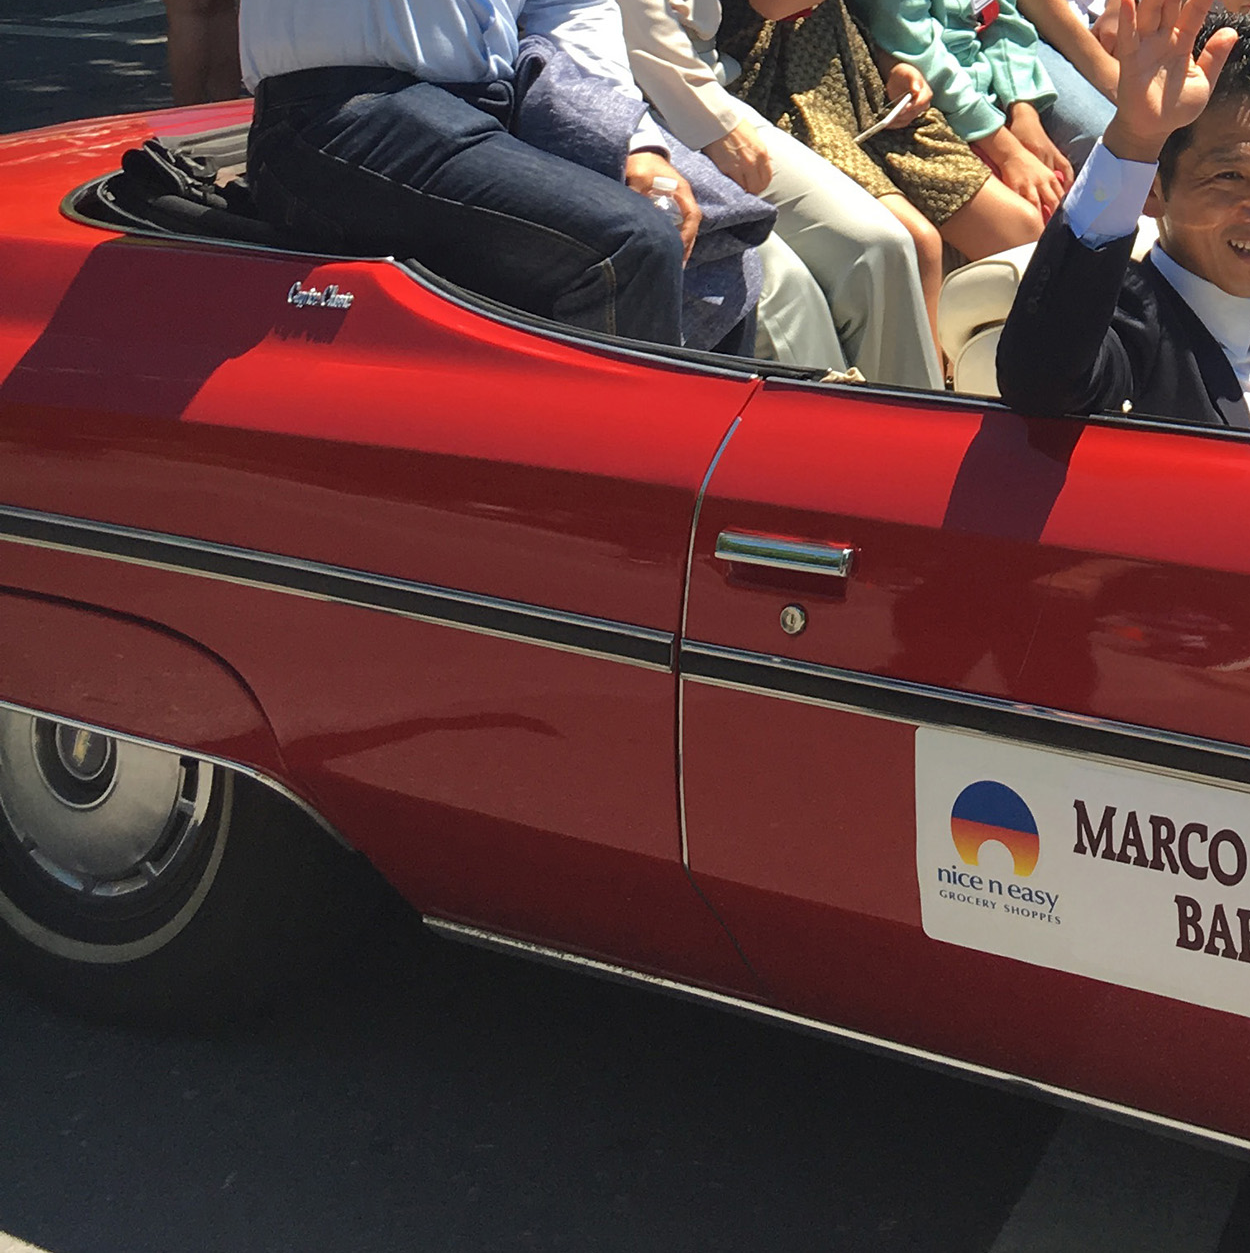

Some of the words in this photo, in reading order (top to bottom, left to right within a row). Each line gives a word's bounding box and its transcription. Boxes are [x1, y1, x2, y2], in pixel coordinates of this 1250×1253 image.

[1073, 799, 1248, 887] MARCO
[937, 865, 983, 891] nice
[988, 878, 1003, 895] n
[1007, 883, 1060, 914] easy
[939, 889, 997, 910] GROCERY
[1003, 904, 1062, 925] SHOPPES
